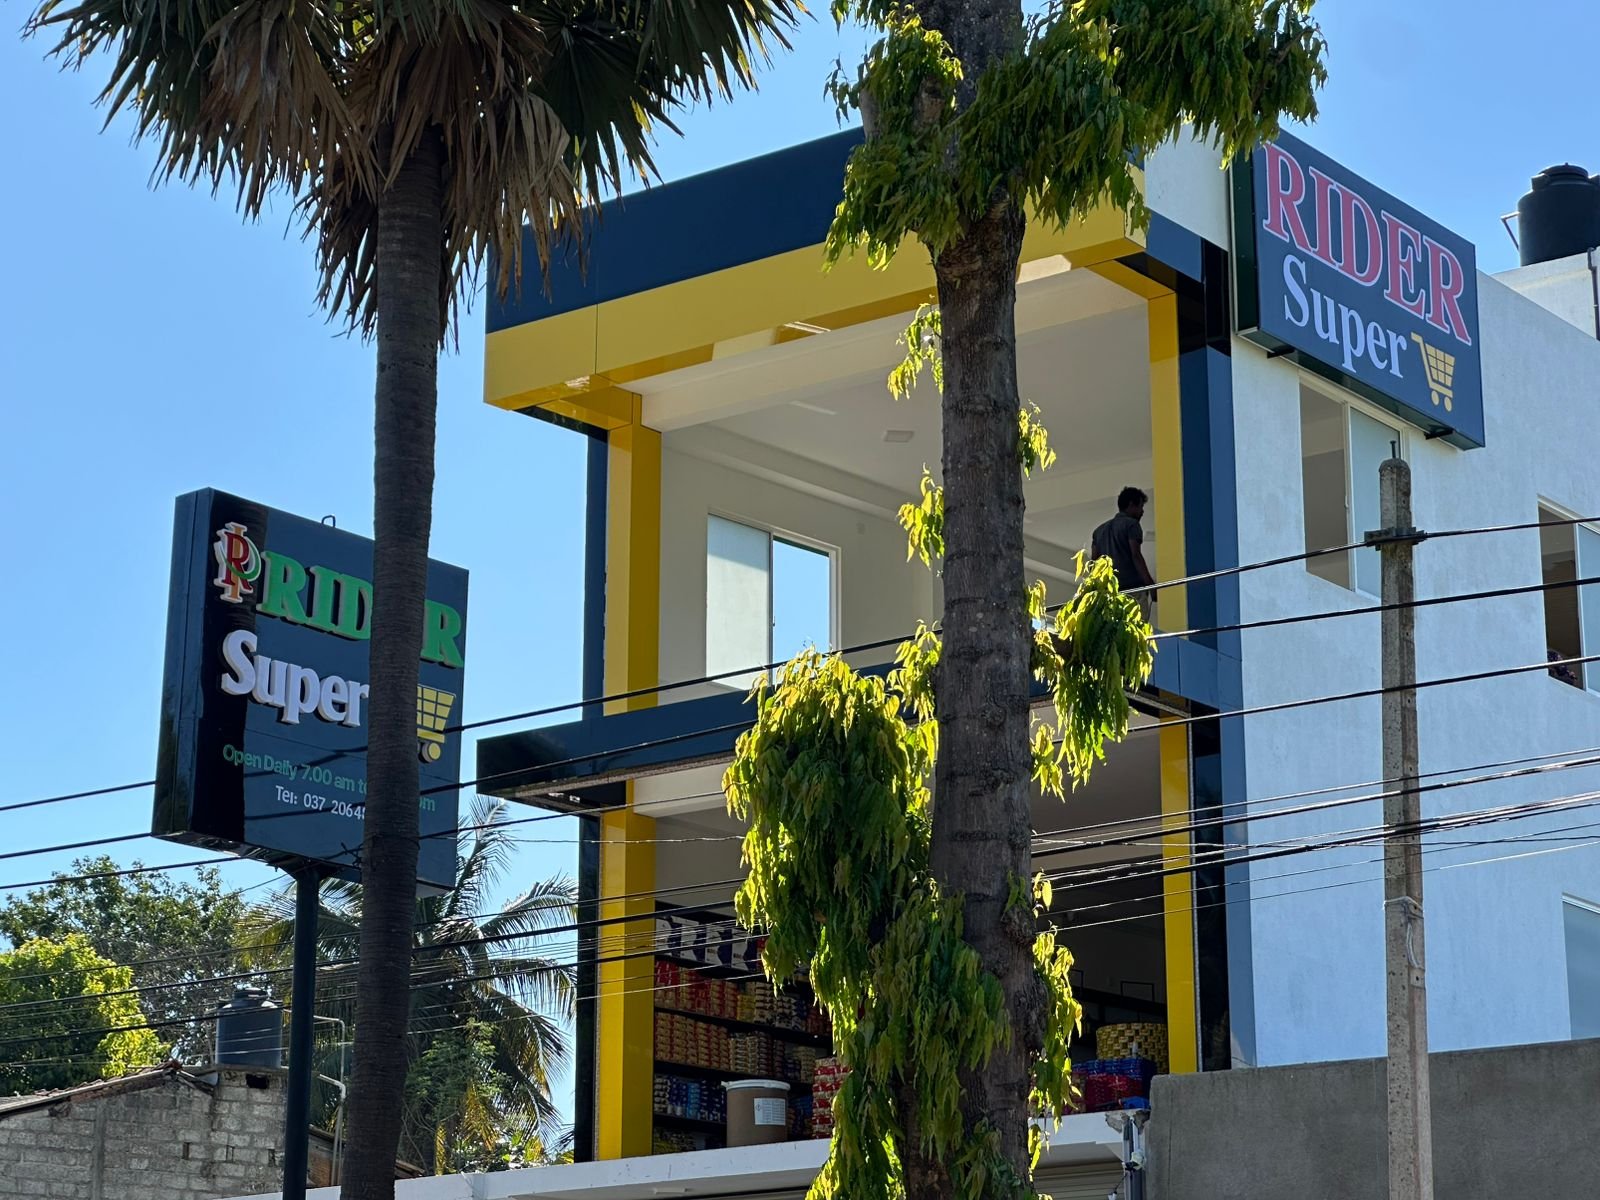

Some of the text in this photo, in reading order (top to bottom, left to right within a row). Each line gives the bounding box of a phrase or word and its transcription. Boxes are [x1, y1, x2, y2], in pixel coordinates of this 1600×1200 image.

[1263, 141, 1471, 346] RIDER
[1283, 254, 1407, 378] Super
[256, 551, 464, 668] RIDR
[221, 629, 370, 728] Super
[222, 744, 262, 767] Open
[264, 755, 298, 781] Daily
[301, 764, 333, 785] 7.00
[334, 775, 355, 792] am
[419, 796, 436, 811] m
[275, 785, 298, 805] Tel:
[303, 793, 326, 811] 037
